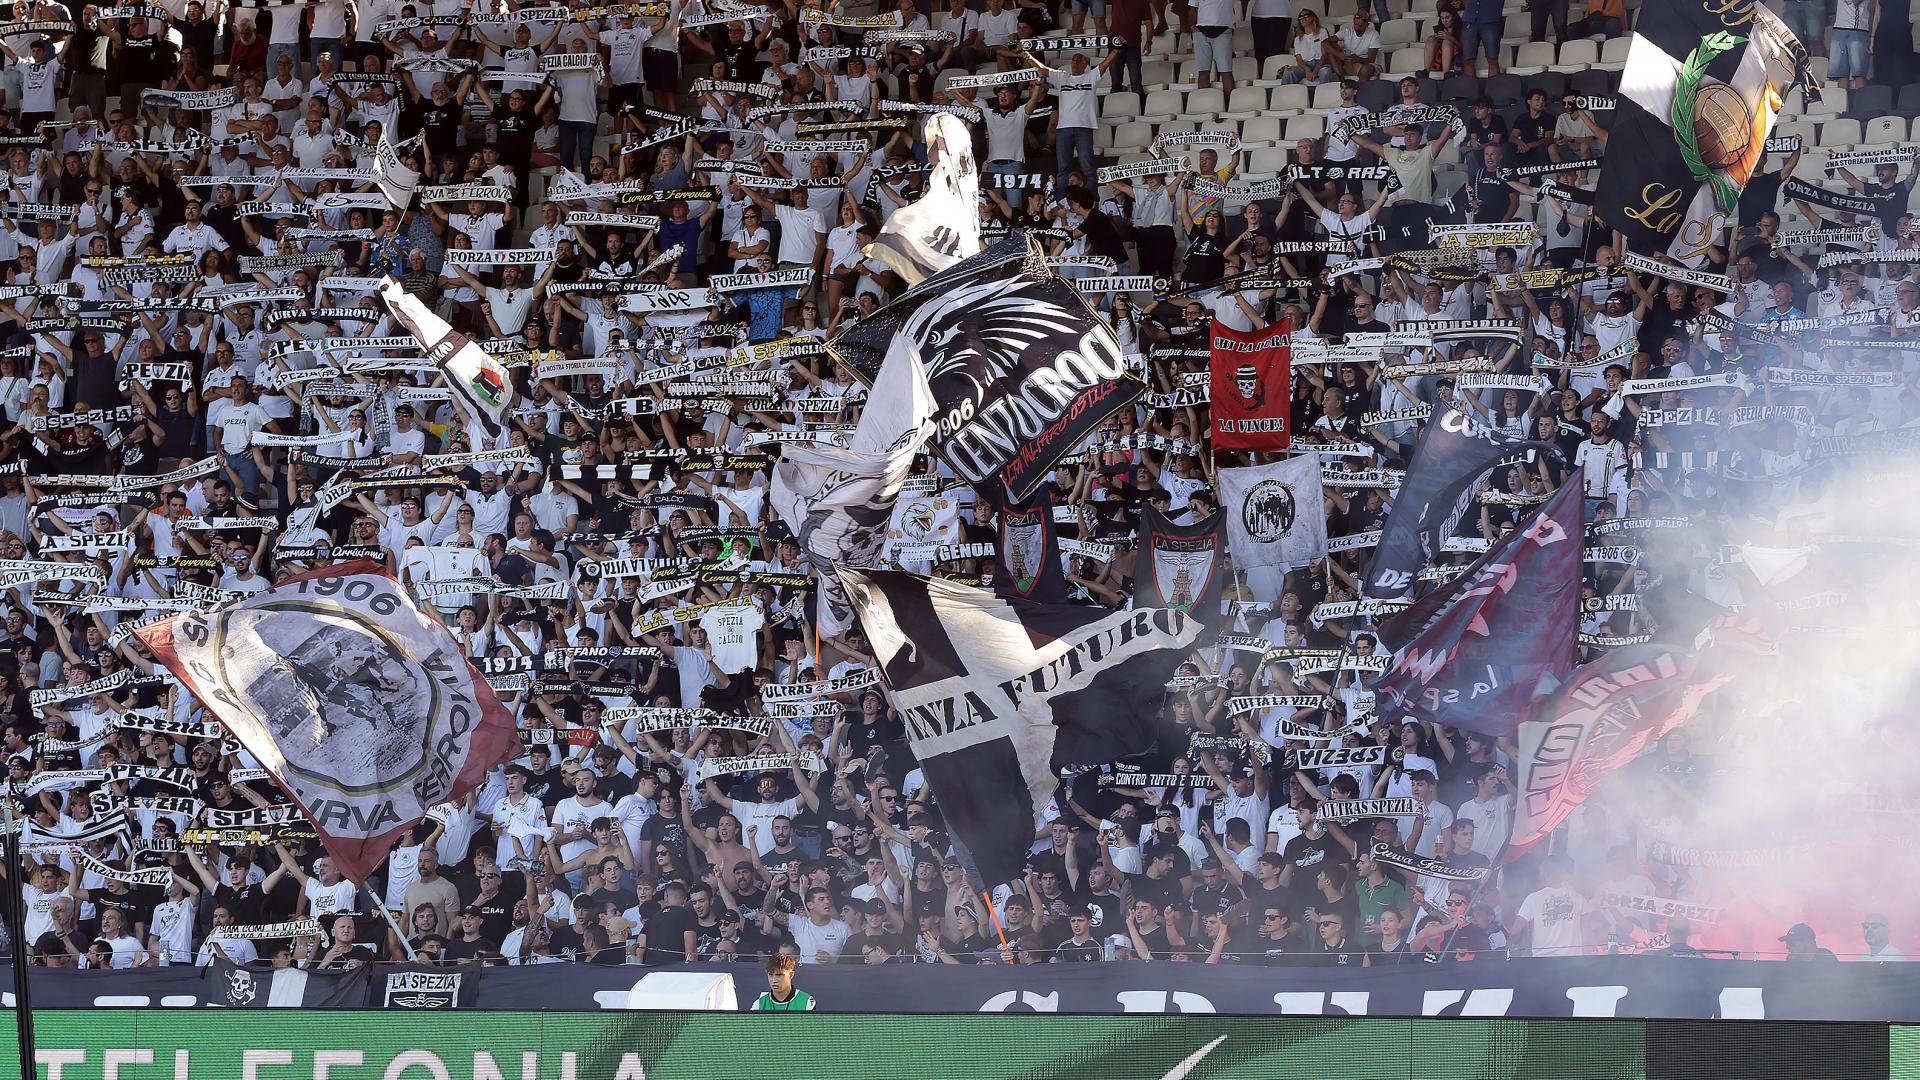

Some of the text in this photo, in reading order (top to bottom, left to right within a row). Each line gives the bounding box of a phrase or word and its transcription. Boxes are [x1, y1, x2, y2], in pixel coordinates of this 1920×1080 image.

[521, 10, 564, 20] SPEZIA
[690, 7, 762, 24] ULTRAS SPEZIA
[805, 8, 898, 24] LA SPEZIA
[376, 16, 463, 31] EZIA CALCIO
[1036, 37, 1109, 49] ANDEMO
[1160, 136, 1230, 147] UNA STORIA INFINITA
[1110, 164, 1179, 179] UNA STORIA INFINITA
[739, 176, 840, 186] SPEZIA CALCIO
[993, 173, 1041, 189] 1974
[1196, 178, 1280, 194] SUPPORTERS SPEZIA
[666, 186, 712, 199] Ferrovia
[1788, 181, 1875, 212] ORZA SPEZIA
[1785, 234, 1863, 245] UNA STORIA INFINITA
[451, 251, 552, 263] FORZA SPEZIA
[161, 266, 197, 278] SPEZIA
[1626, 255, 1734, 289] ULTRAS SPEZIA
[551, 282, 603, 294] ORGOGLIO
[712, 274, 753, 288] FORZA
[1078, 278, 1151, 291] TUTTA LA VITA
[1240, 280, 1281, 288] SPEZIA
[0, 287, 23, 297] ORZA
[25, 317, 126, 331] GRUPPO BULLONE
[1838, 311, 1875, 325] SPEZIA
[1386, 332, 1431, 341] Pericolose
[728, 349, 749, 366] LA
[1326, 349, 1374, 358] Pericolose
[697, 356, 725, 368] CALC
[276, 371, 317, 387] SPEZIA
[1632, 375, 1712, 391] Non siete soli
[1835, 373, 1873, 384] SPEZIA
[49, 407, 132, 429] SPEZIA
[224, 418, 246, 426] SPEZIA
[935, 397, 974, 444] 1906
[654, 495, 684, 503] CALCIO
[680, 528, 712, 538] SPEZIA
[1155, 539, 1214, 551] LA SPEZIA
[1597, 545, 1619, 560] 1906
[756, 573, 807, 586] Ferrovia
[422, 583, 480, 596] ULTRAS
[638, 614, 667, 630] LA
[718, 617, 744, 627] SPEZIA
[719, 635, 743, 644] CALCIO
[483, 657, 534, 673] 1974
[997, 610, 1184, 711] FUTURO
[765, 673, 876, 699] ULTRAS SPEZIA
[1272, 696, 1288, 707] LA
[1290, 696, 1320, 707] VITA
[124, 712, 205, 734] SPEZIA
[1301, 747, 1384, 768] SPEZIA
[718, 760, 758, 774] PROVA A
[1115, 773, 1214, 787] CONTRO TUTTO E TUTTI
[1321, 798, 1413, 818] ULTRAS SPEZIA
[244, 923, 269, 933] COME
[392, 974, 456, 990] LA SPEZIA
